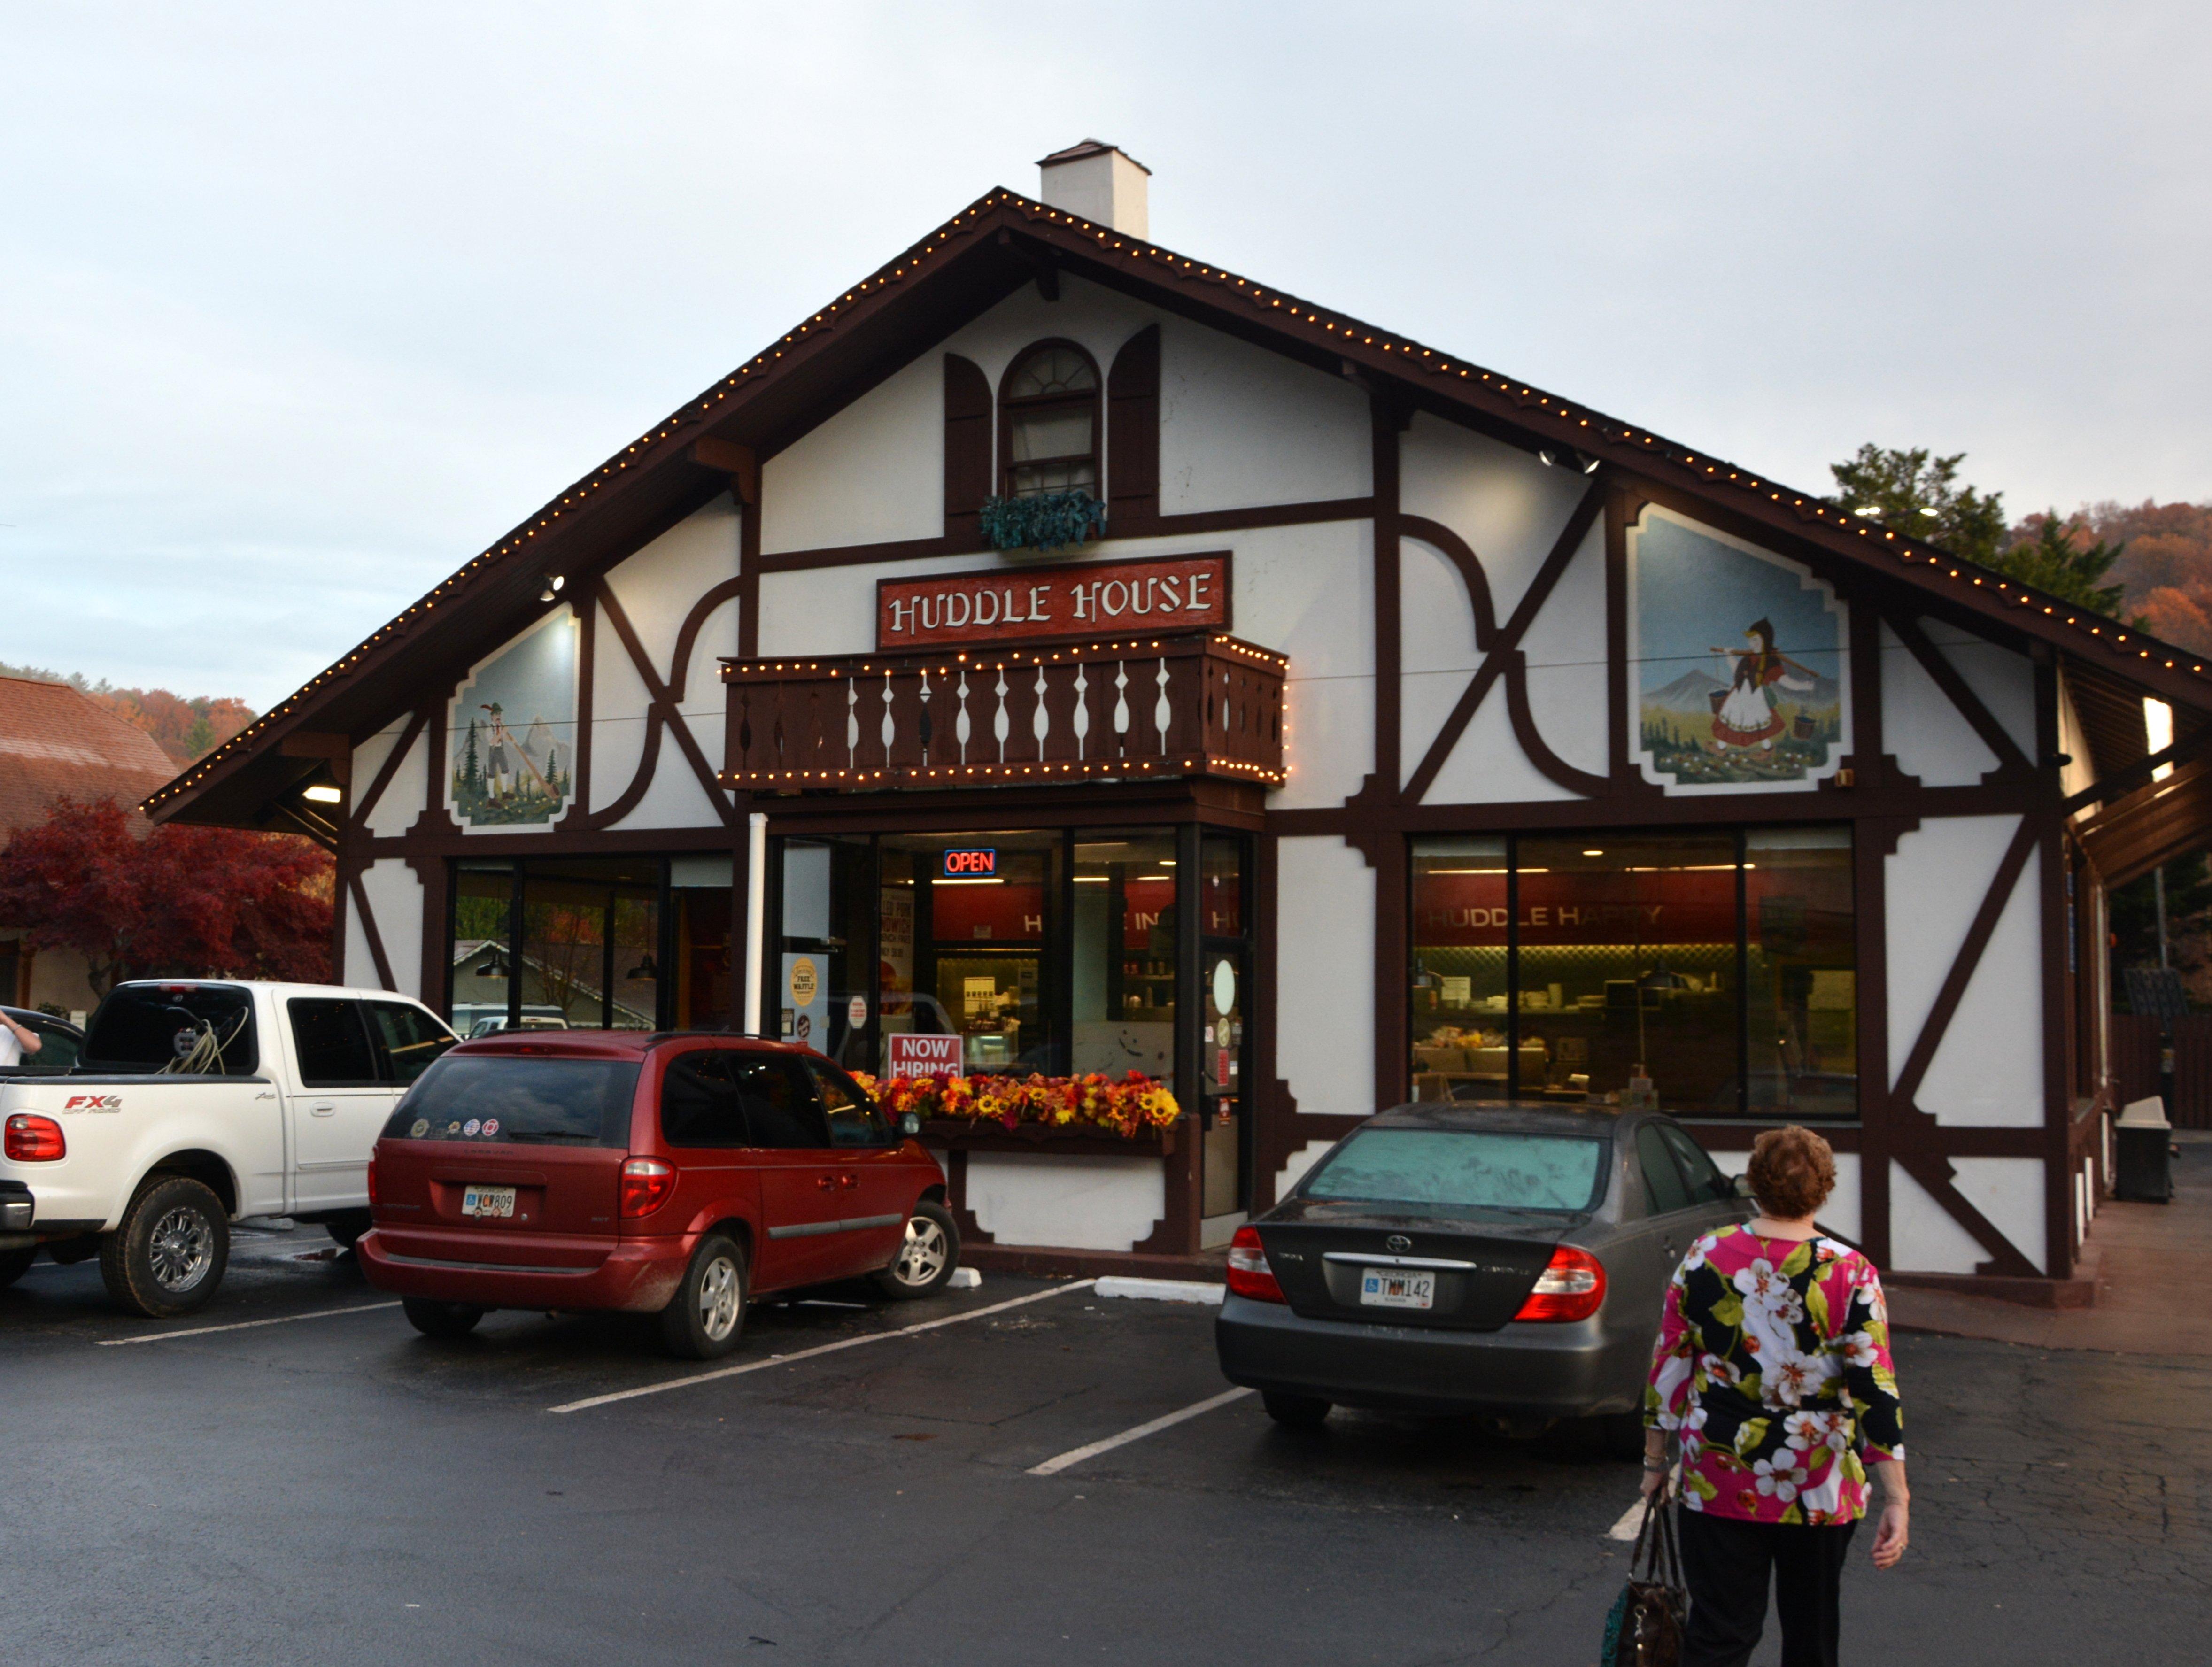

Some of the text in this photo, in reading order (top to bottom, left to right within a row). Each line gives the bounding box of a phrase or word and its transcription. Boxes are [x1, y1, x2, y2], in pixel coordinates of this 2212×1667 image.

[889, 573, 1212, 635] HUDDLE HOUSE
[946, 852, 994, 872] OPEN
[902, 1038, 950, 1057] NOW
[893, 1060, 959, 1079] HIRING
[65, 1095, 123, 1109] FX4
